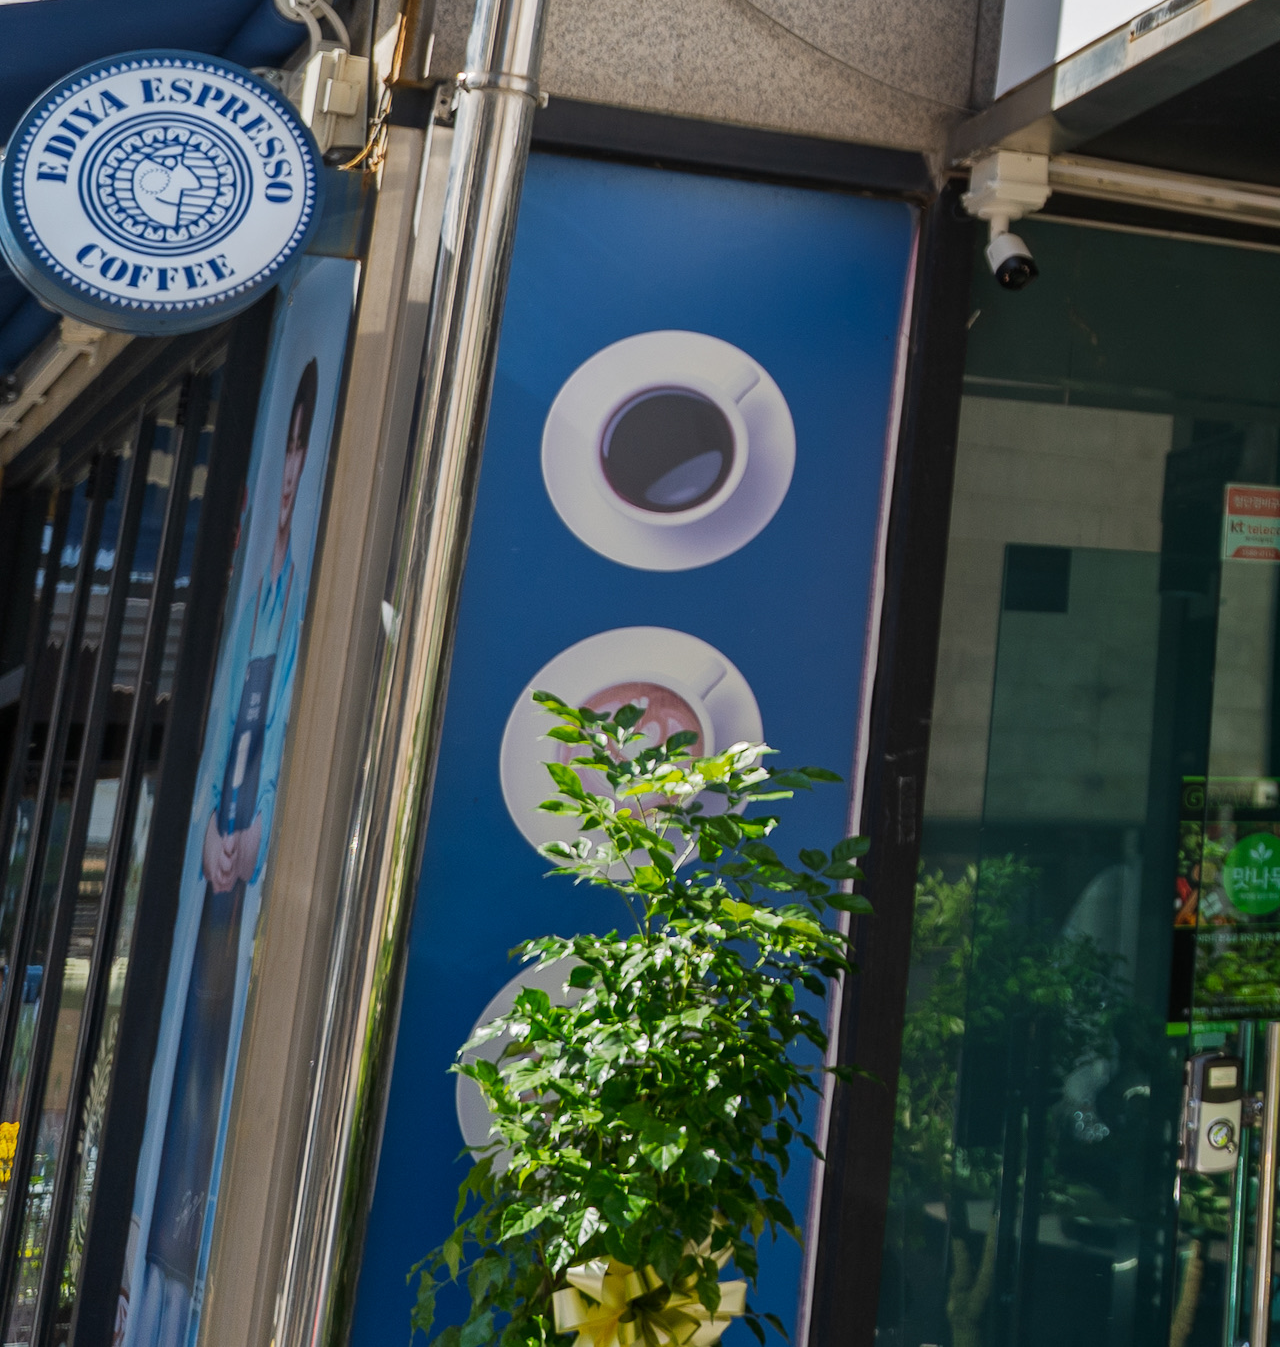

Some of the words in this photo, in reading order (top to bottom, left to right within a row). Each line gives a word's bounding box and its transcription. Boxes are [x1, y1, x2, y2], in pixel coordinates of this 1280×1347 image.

[36, 88, 129, 185] EDIYA
[139, 76, 294, 205] ESPRESSO
[75, 242, 237, 292] COFFEE
